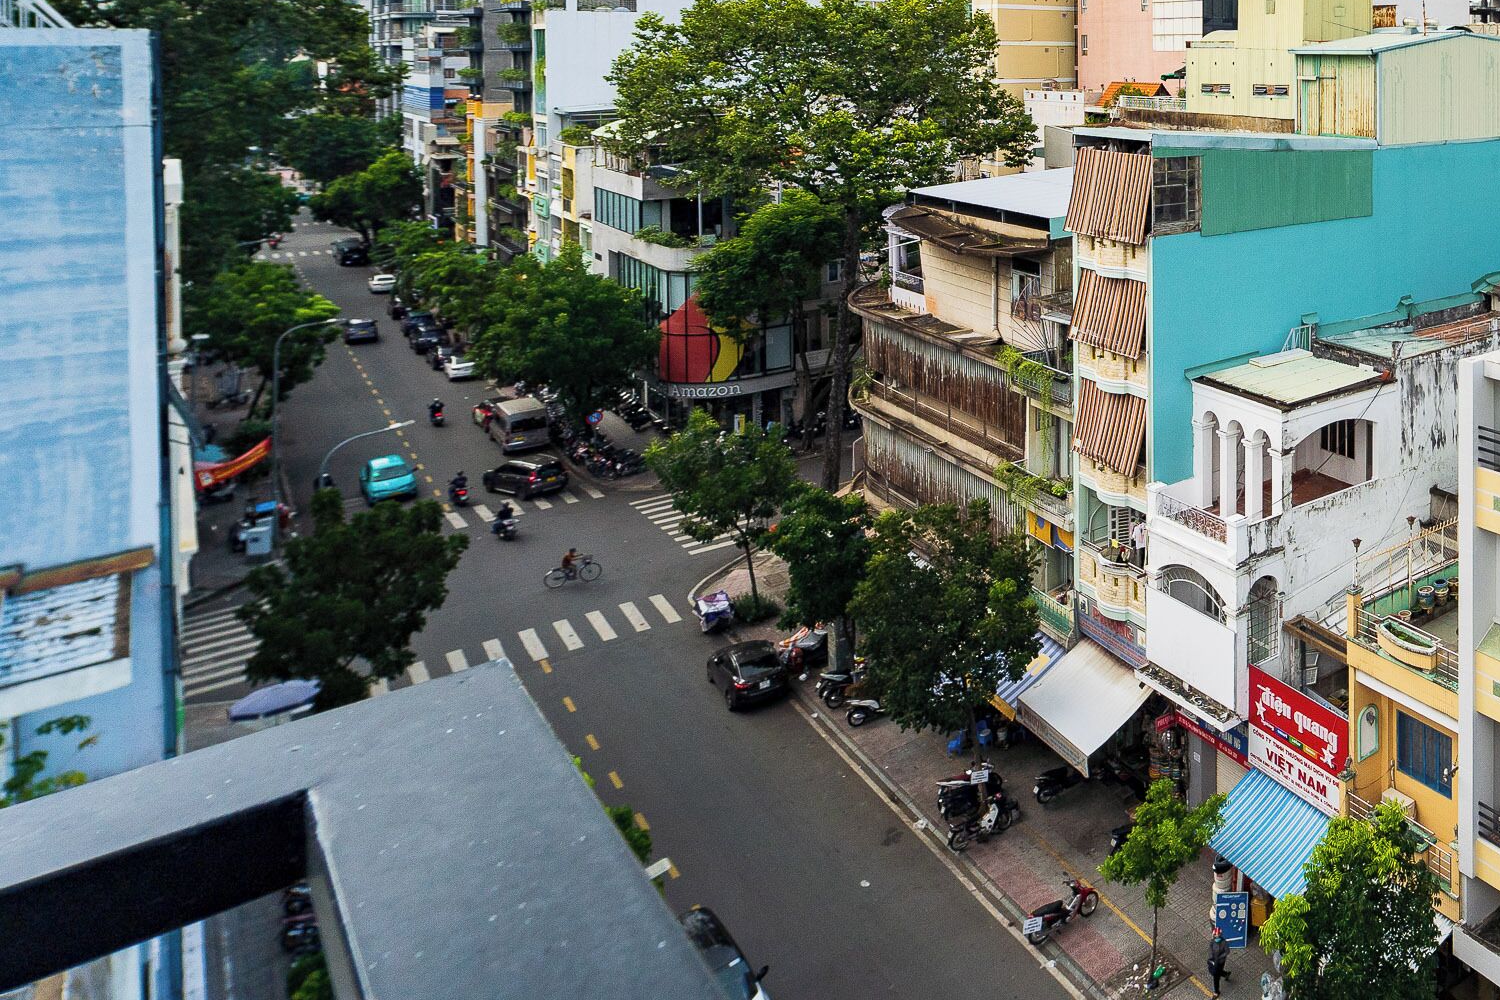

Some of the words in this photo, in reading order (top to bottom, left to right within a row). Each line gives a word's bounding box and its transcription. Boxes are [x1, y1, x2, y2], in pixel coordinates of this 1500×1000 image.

[671, 384, 741, 397] Amazon
[1265, 736, 1272, 744] TY
[1294, 711, 1338, 753] quang
[1266, 747, 1294, 775] VIỆT
[1297, 768, 1327, 798] NAM
